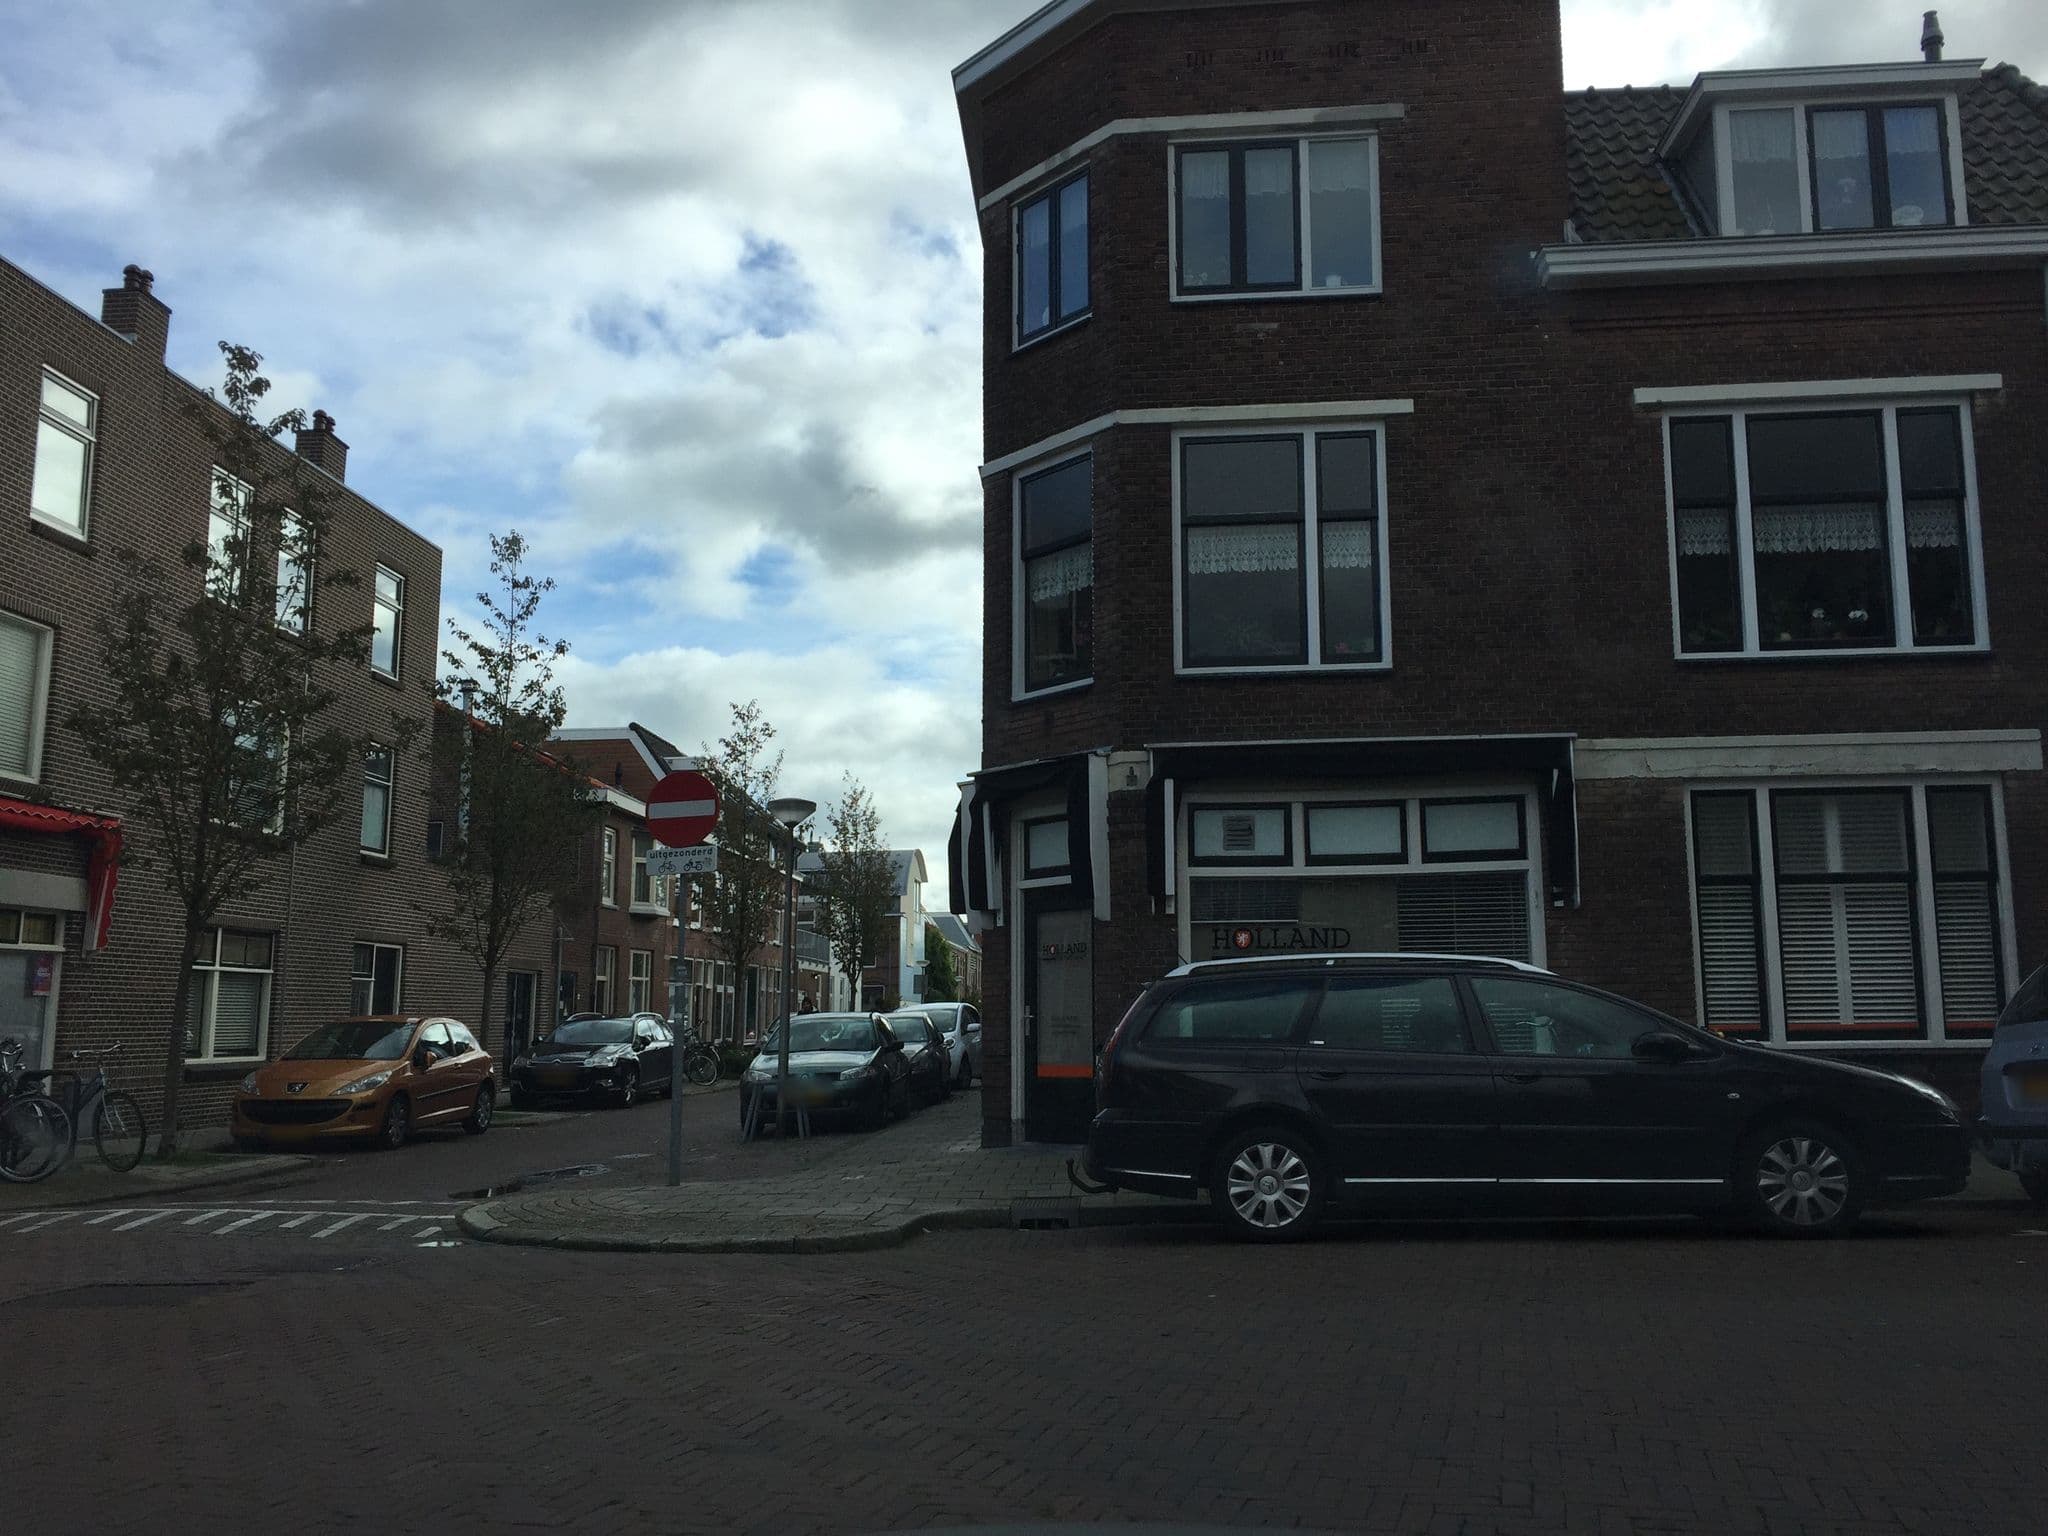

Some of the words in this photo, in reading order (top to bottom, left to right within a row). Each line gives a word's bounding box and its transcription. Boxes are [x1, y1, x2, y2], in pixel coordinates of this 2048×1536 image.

[649, 848, 713, 859] uitgezonderd
[1212, 927, 1351, 951] HOLLAND
[1042, 943, 1088, 955] HOLLAND
